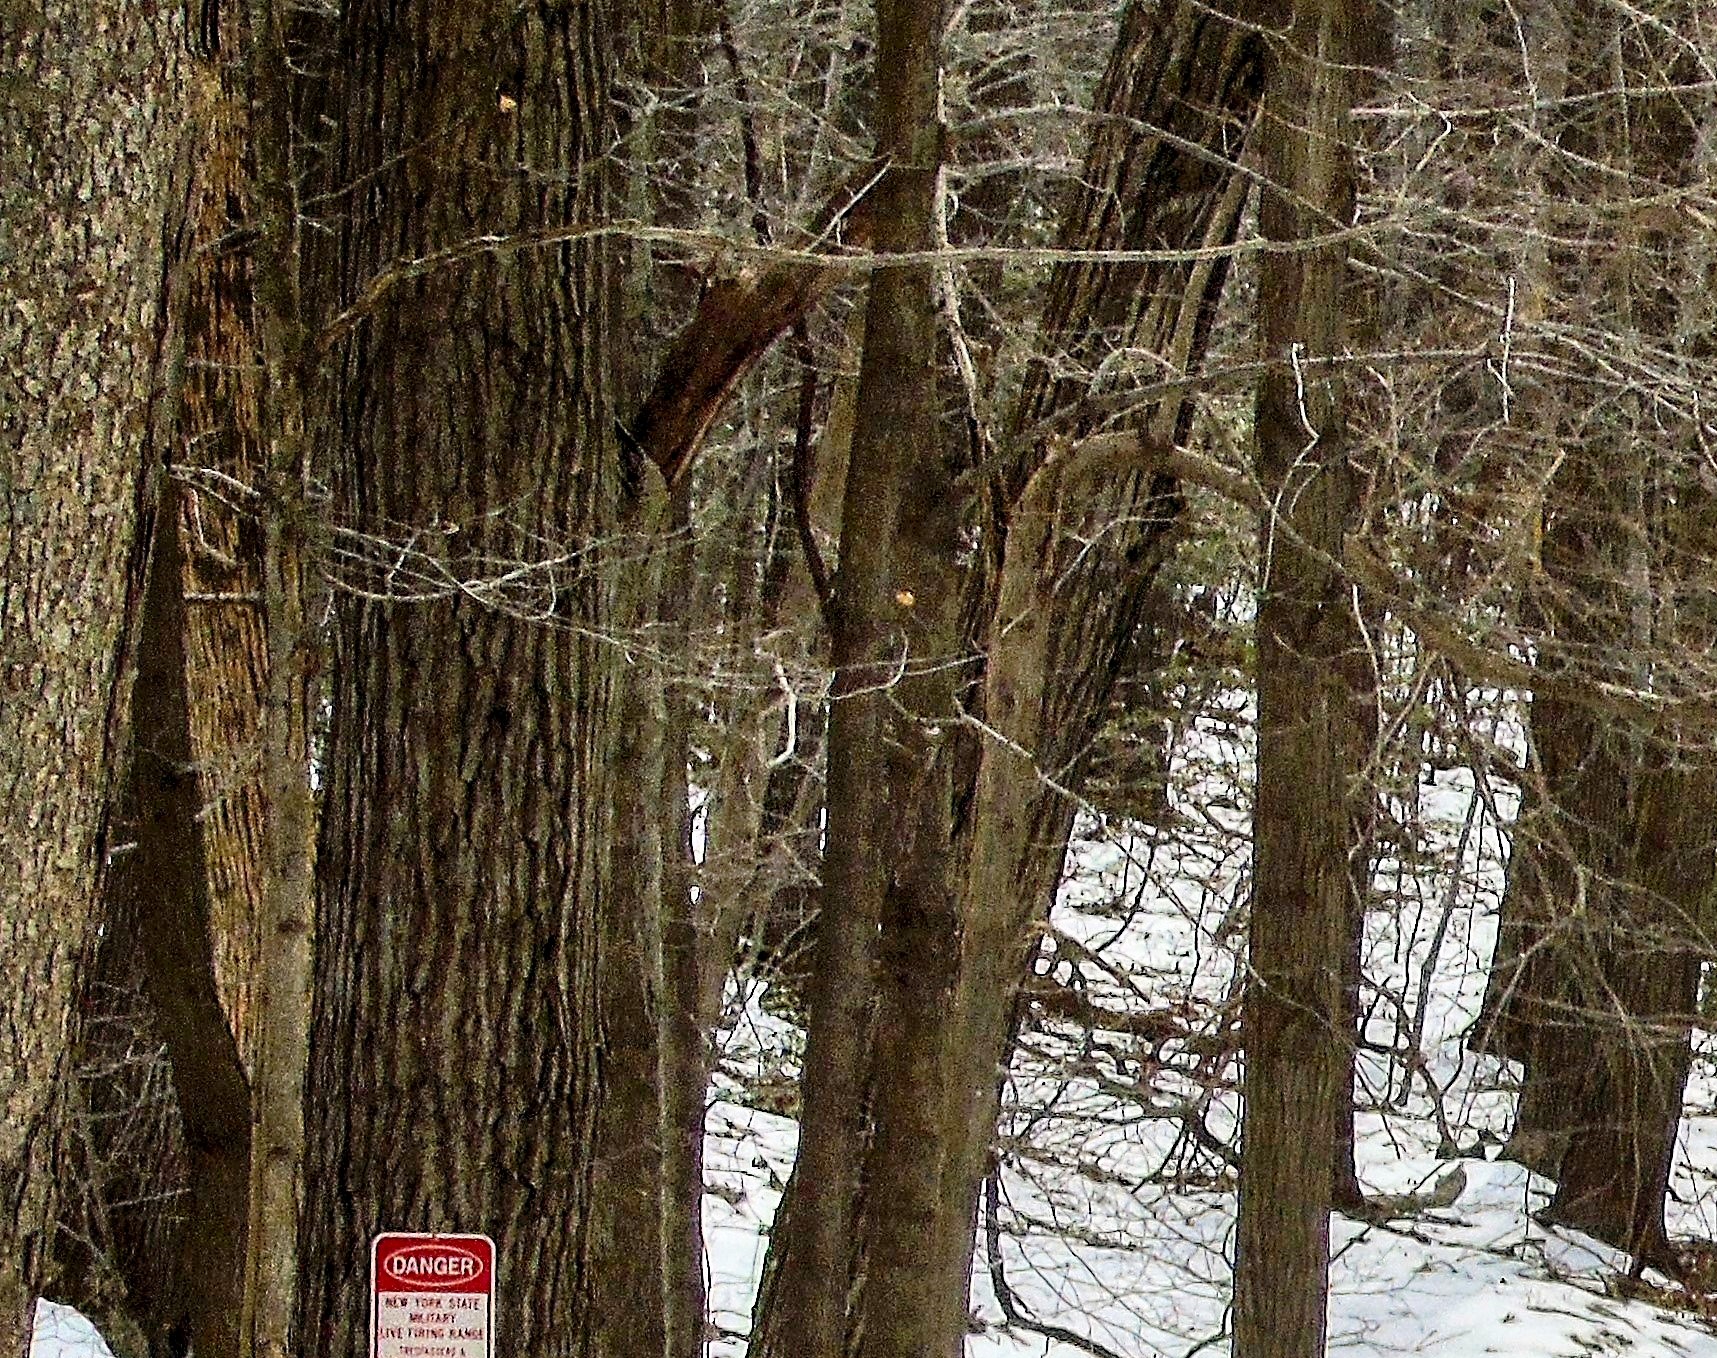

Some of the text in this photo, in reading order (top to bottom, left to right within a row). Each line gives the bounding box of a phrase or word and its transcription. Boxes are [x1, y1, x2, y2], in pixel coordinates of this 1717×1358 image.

[393, 1256, 475, 1276] DANGER
[384, 1297, 480, 1310] NEW YORK STATE
[409, 1312, 457, 1323] MILITARY
[379, 1327, 484, 1340] LIVE FIRING RANGE
